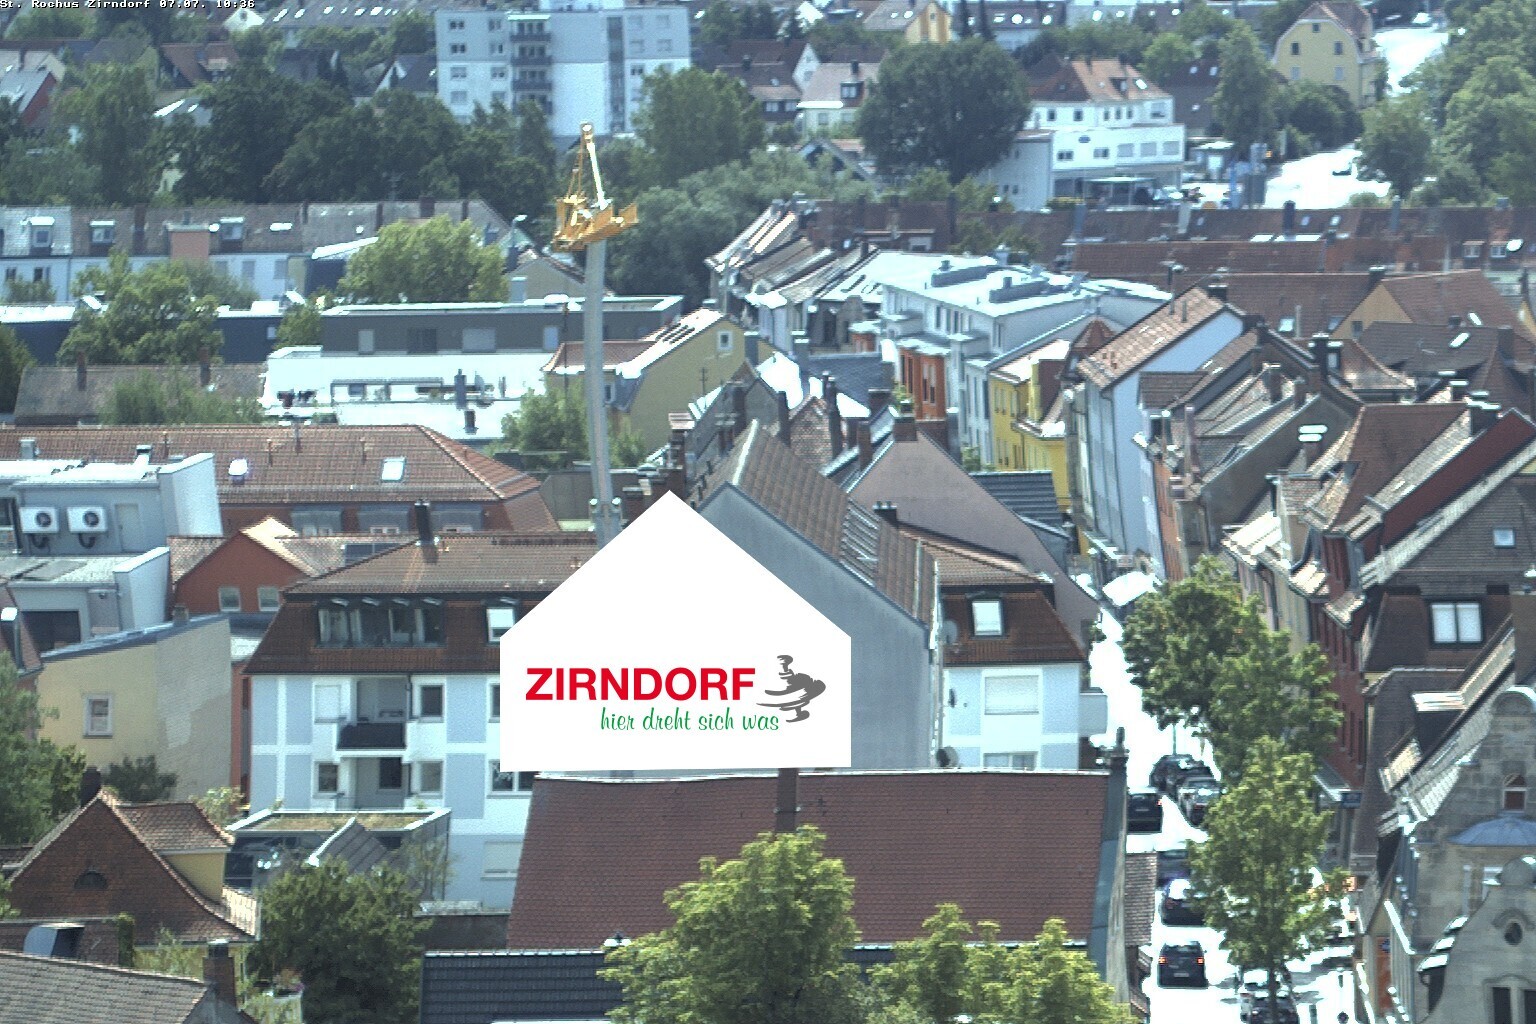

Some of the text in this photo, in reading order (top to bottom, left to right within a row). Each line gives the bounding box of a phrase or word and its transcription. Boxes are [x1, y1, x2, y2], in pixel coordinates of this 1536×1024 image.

[526, 667, 755, 701] ZIRNDORF
[601, 707, 779, 730] hier dreht sich was
